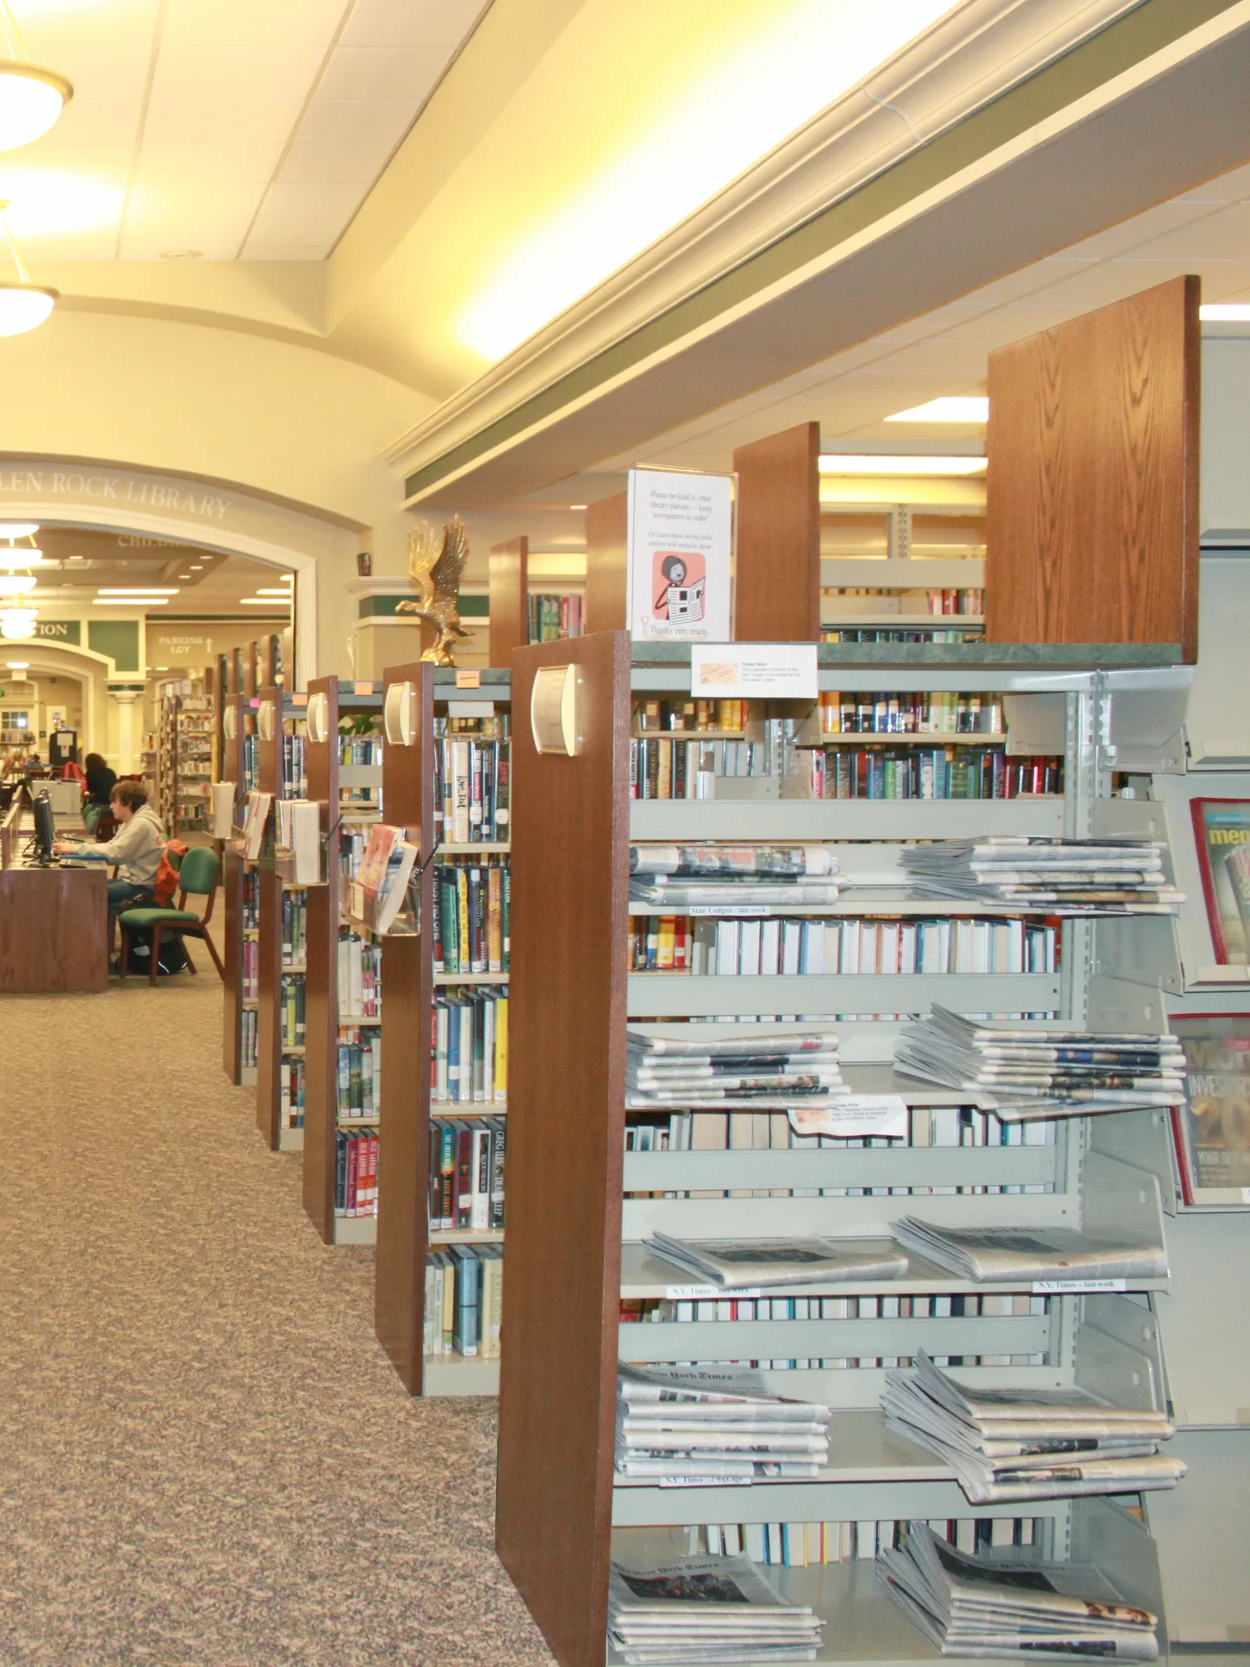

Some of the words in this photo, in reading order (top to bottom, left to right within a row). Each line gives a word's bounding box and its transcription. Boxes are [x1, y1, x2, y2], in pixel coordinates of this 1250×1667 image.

[52, 473, 120, 499] ROCK
[125, 480, 233, 520] LIBRARY
[650, 625, 673, 635] Thanks
[674, 627, 688, 637] very
[158, 636, 203, 644] PARKING
[171, 645, 190, 653] LOT
[708, 907, 732, 915] Ledger
[496, 1131, 505, 1150] GREG
[495, 1151, 504, 1165] ILES
[669, 1371, 697, 1380] York
[699, 1371, 733, 1380] Times
